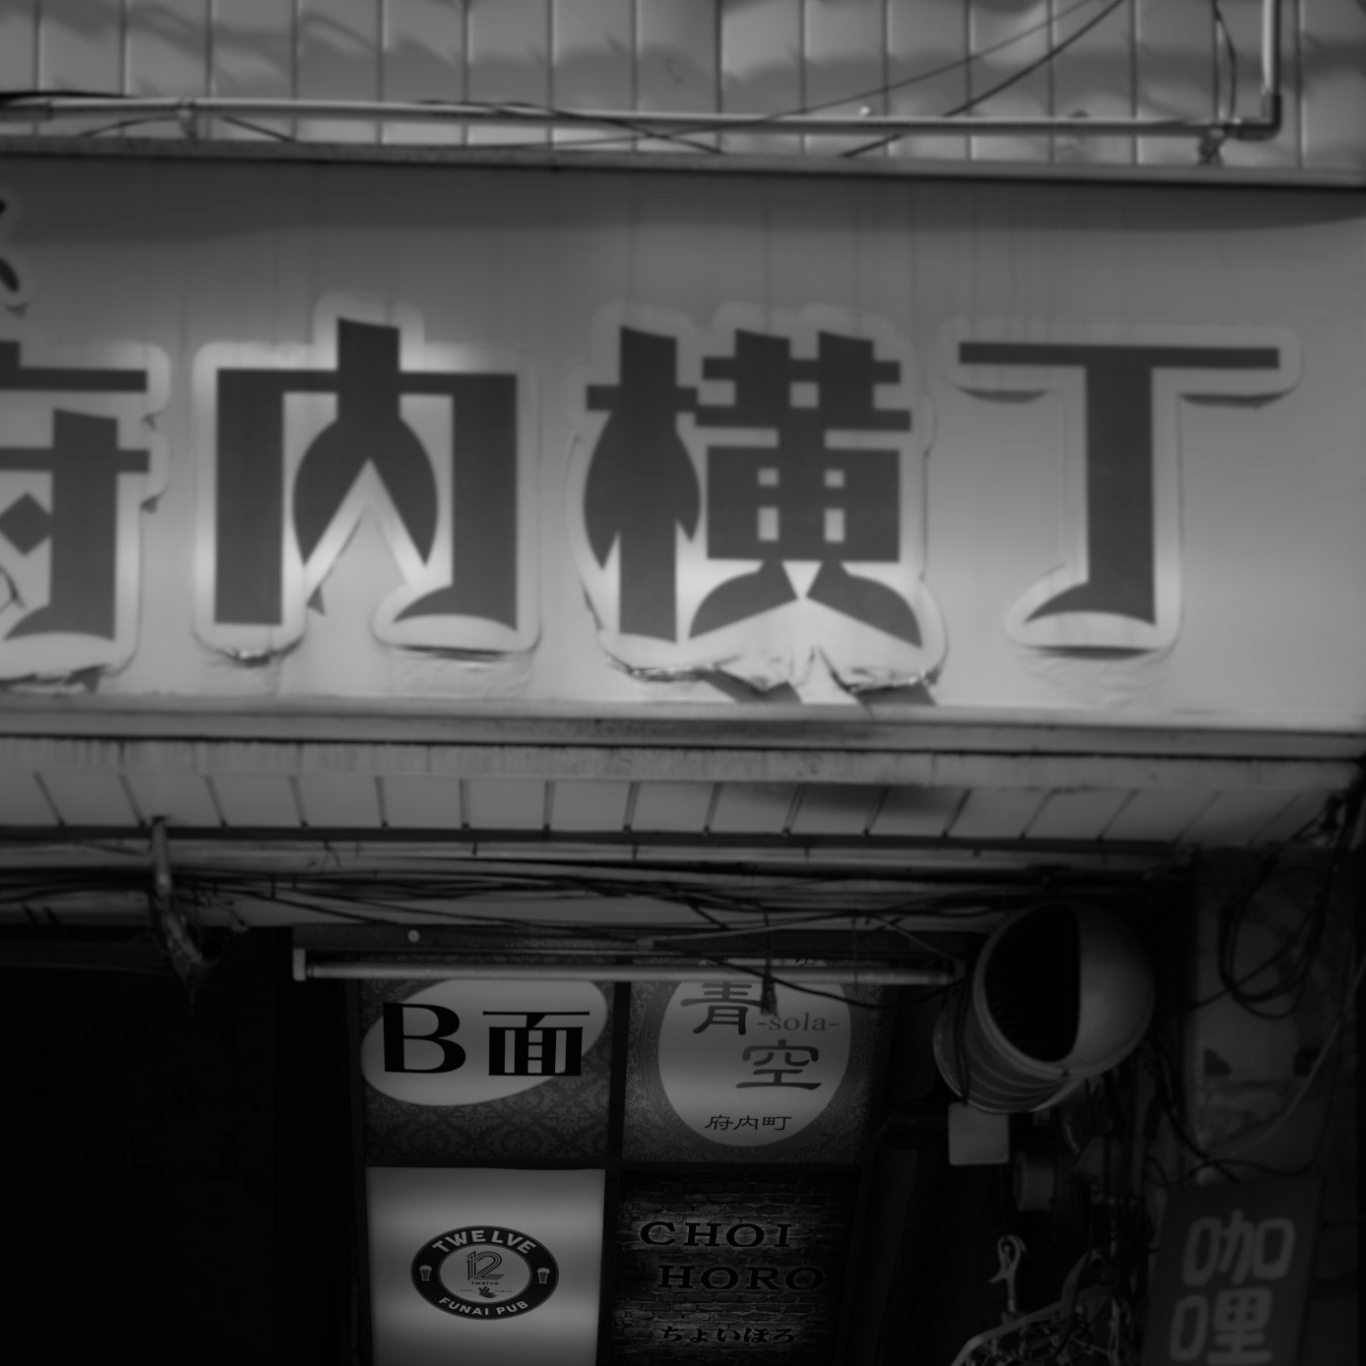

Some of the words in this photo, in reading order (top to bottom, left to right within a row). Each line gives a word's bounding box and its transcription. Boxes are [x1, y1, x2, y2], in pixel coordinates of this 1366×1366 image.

[382, 1002, 591, 1077] B面
[704, 1114, 793, 1132] 府内町
[430, 1228, 538, 1256] TWELVE
[639, 1221, 791, 1249] CHOI
[465, 1250, 504, 1281] 12
[657, 1264, 824, 1291] HORO
[438, 1295, 490, 1317] FUNAI
[496, 1299, 530, 1317] PUB
[662, 1326, 795, 1343] ちょいほろ
